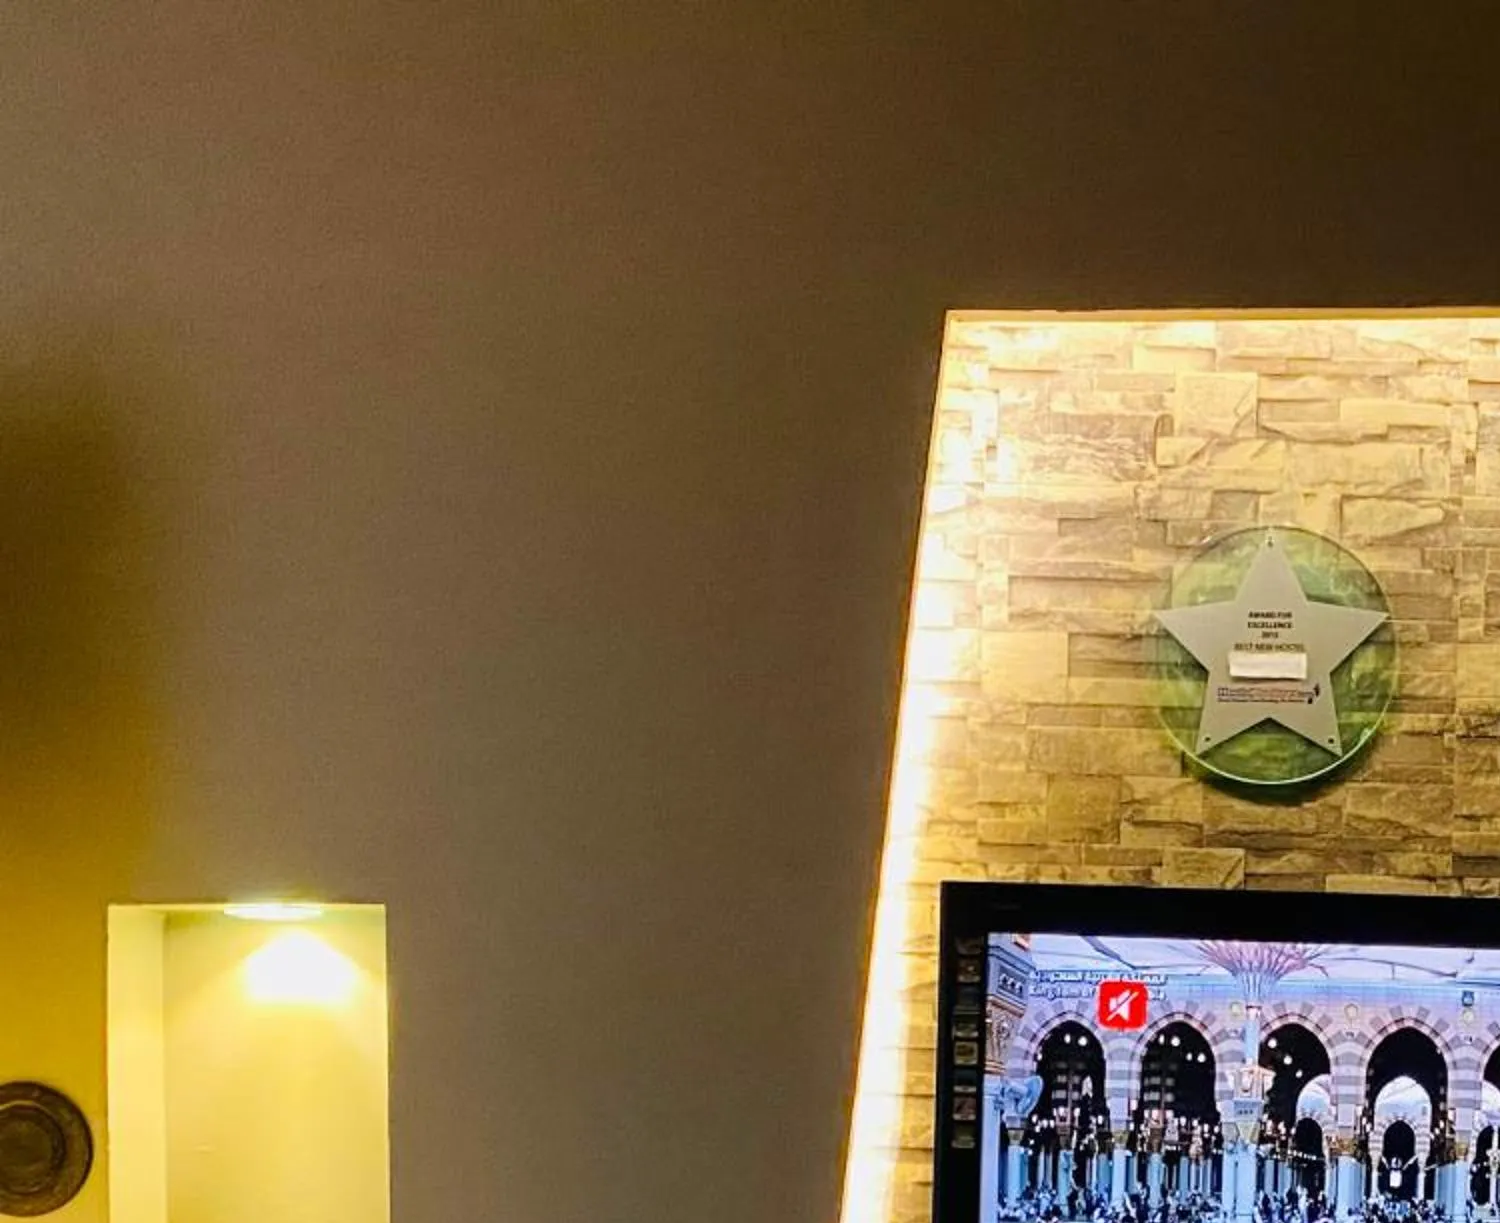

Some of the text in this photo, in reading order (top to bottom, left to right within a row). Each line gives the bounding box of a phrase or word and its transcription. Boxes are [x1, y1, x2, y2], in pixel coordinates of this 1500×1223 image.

[1248, 611, 1293, 619] AWARD FOR
[1247, 621, 1293, 629] EXCELLENCE
